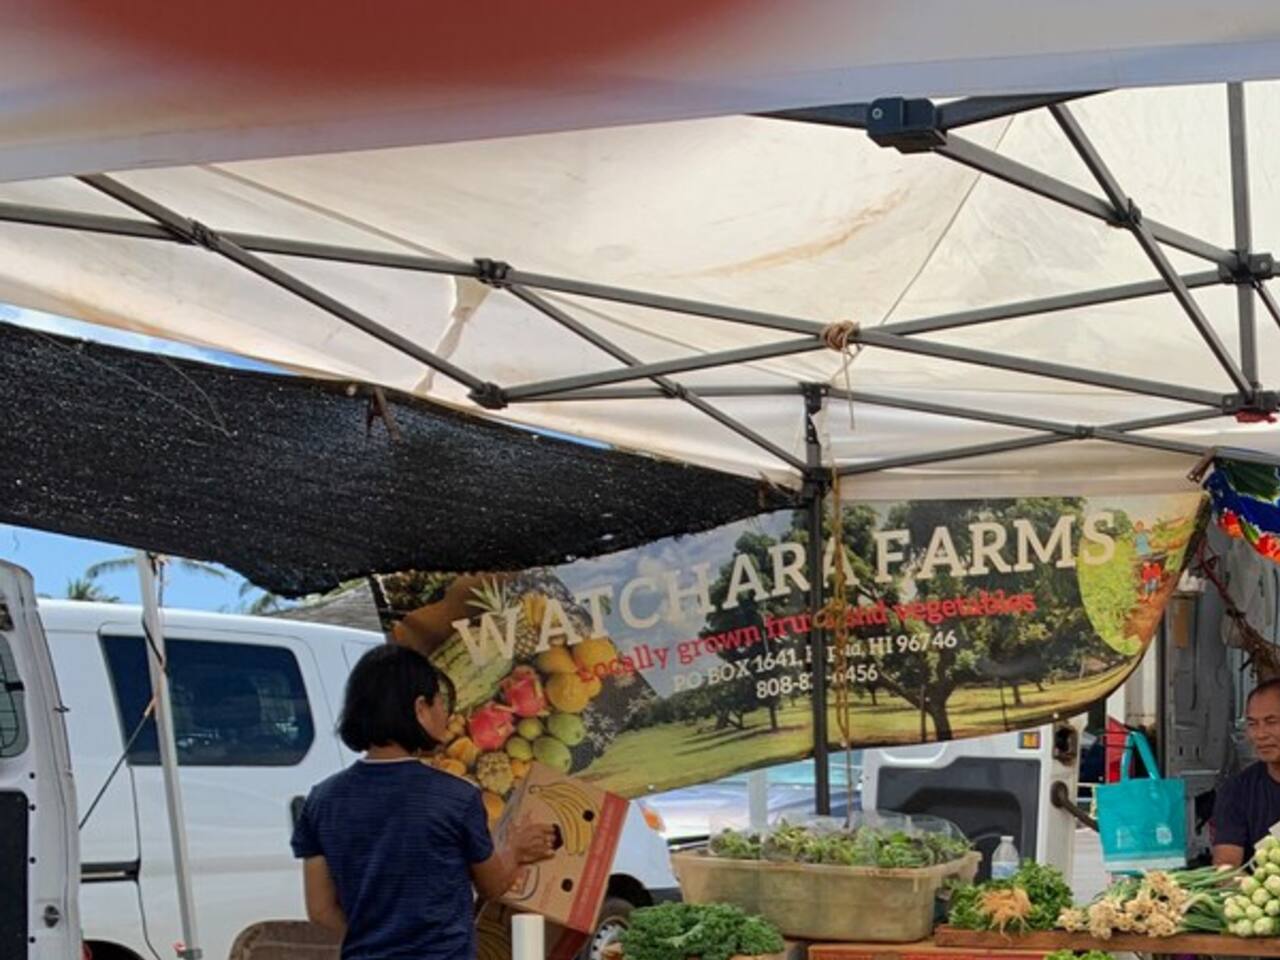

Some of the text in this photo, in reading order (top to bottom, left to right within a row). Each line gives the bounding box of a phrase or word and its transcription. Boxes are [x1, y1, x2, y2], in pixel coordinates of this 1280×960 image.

[452, 511, 1116, 667] WATCHARA FARMS
[677, 624, 762, 665] grown
[893, 589, 1037, 625] vegetables
[673, 671, 702, 694] PO
[707, 660, 752, 686] BOX
[868, 636, 893, 655] HI
[896, 629, 958, 653] 96746
